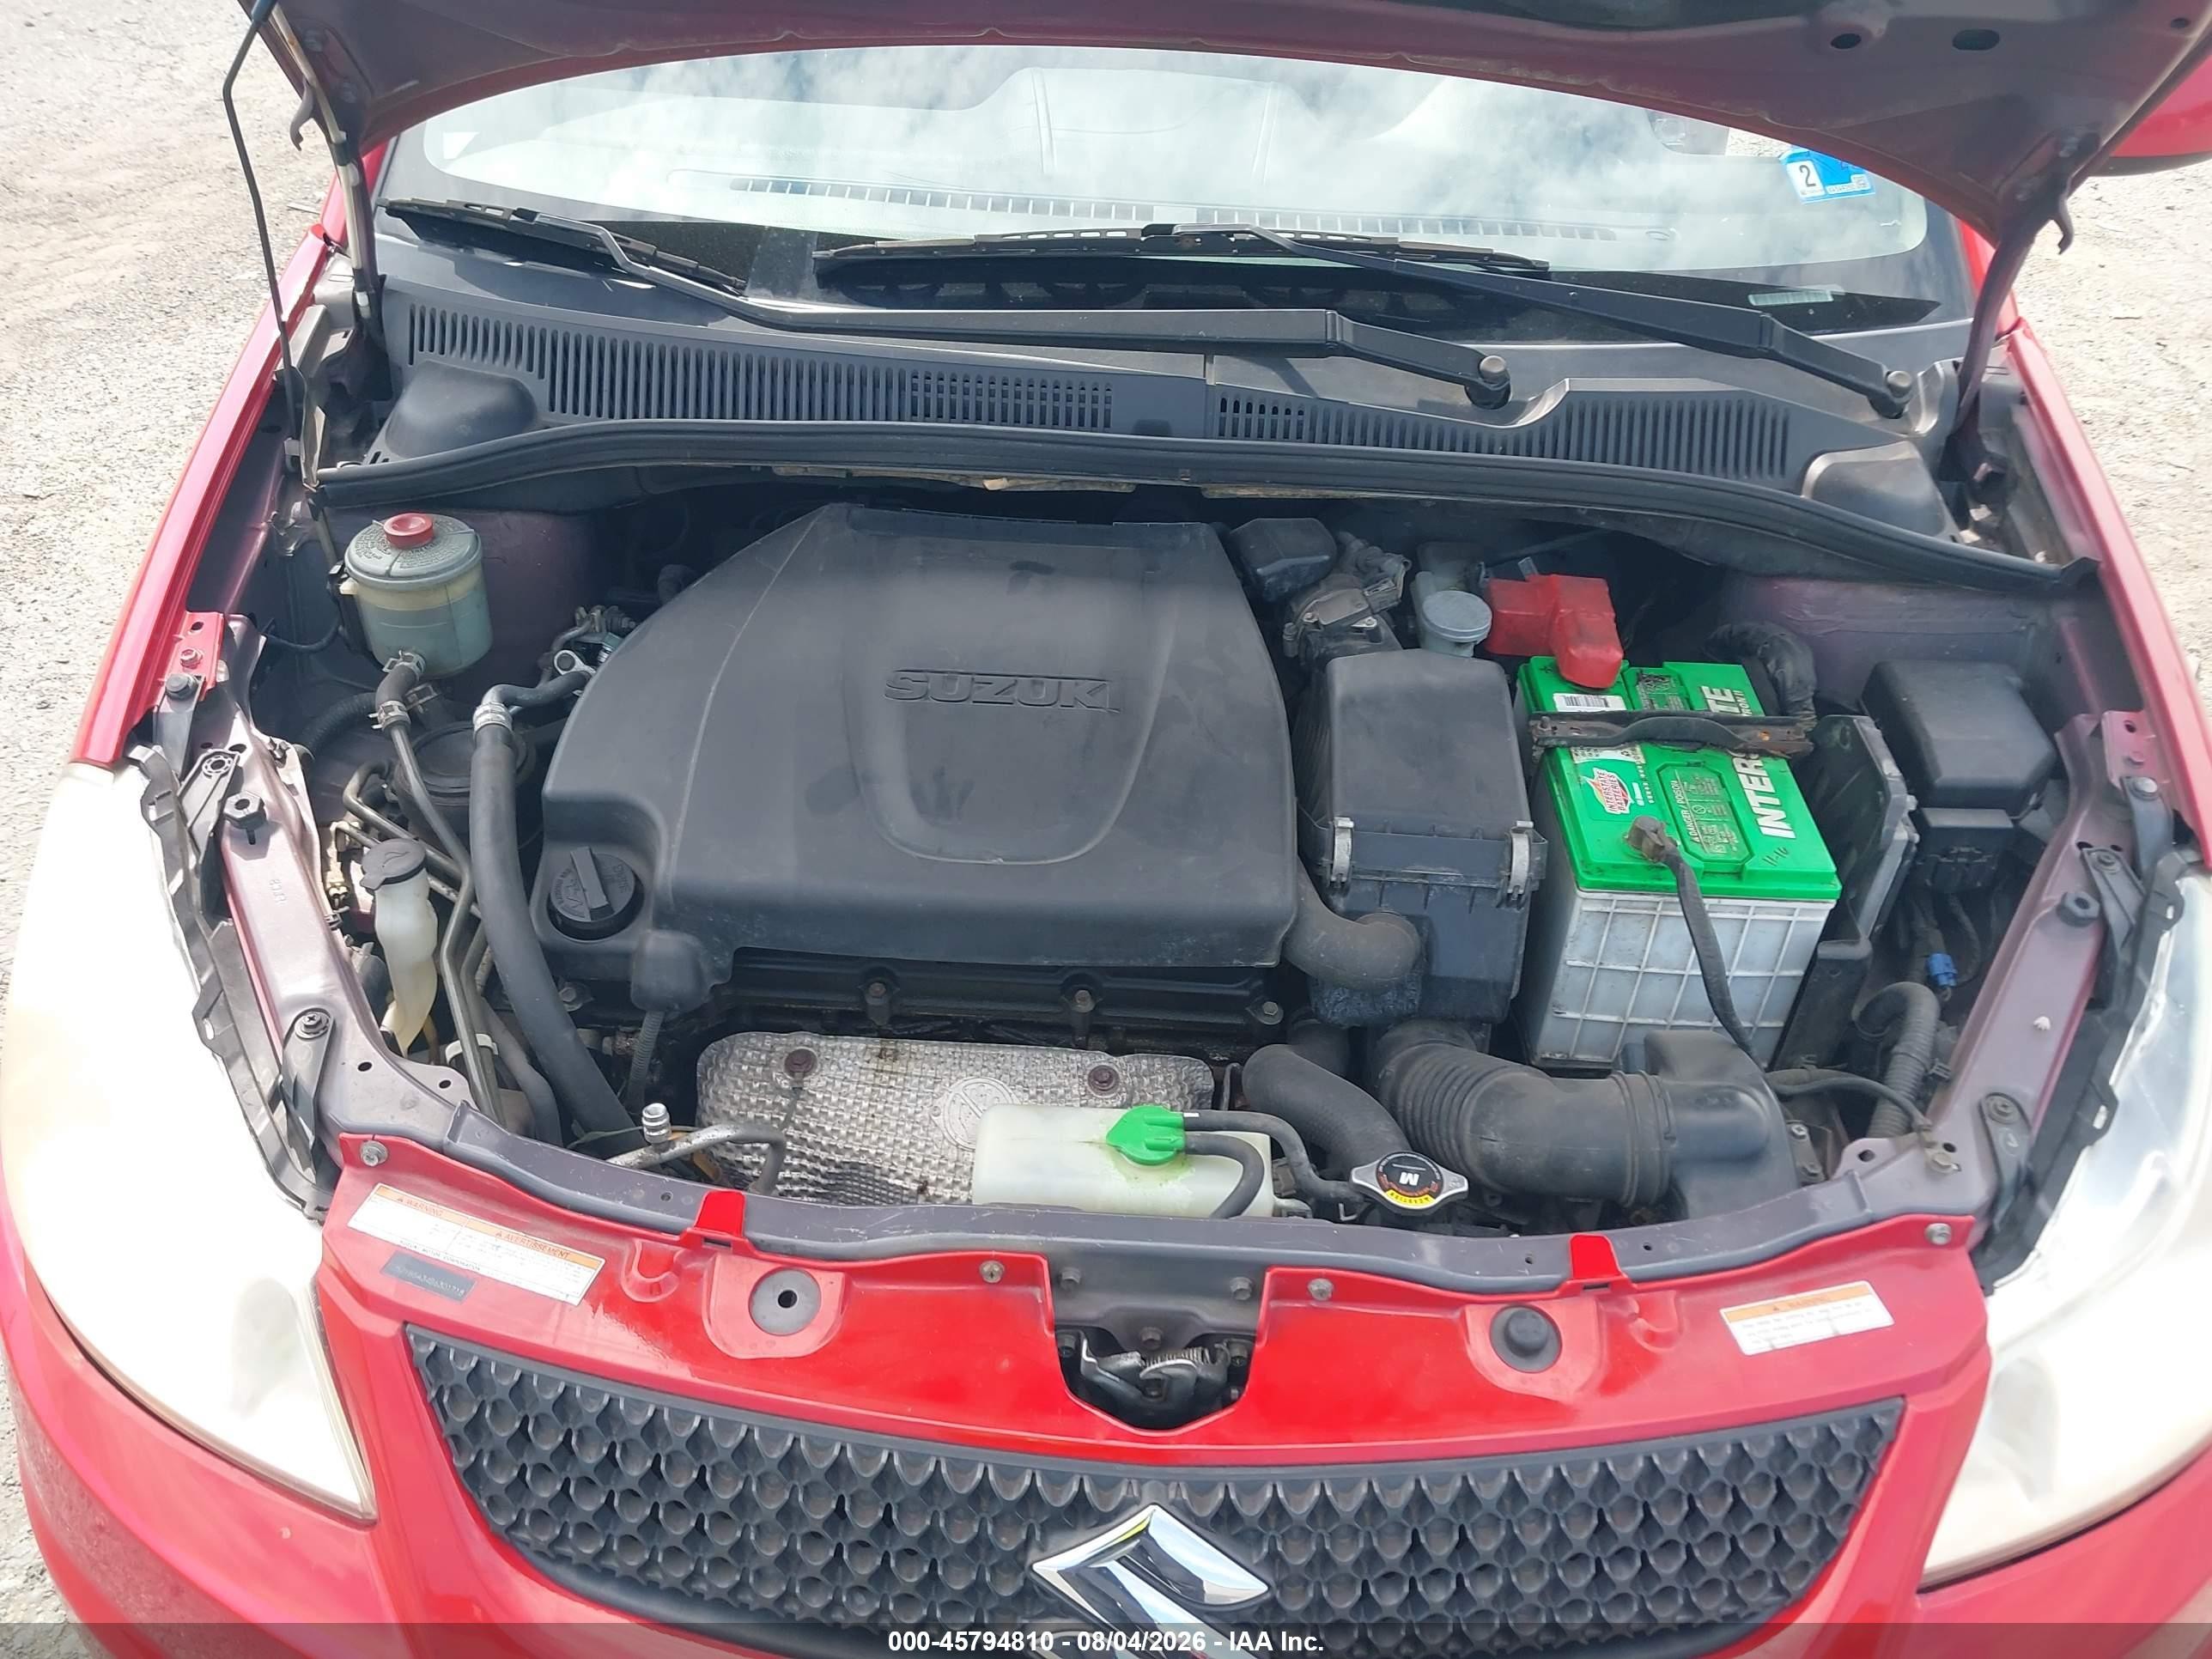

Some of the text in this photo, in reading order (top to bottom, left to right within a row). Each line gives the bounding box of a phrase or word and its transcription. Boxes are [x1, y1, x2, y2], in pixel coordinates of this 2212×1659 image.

[1799, 164, 1816, 187] 2
[1670, 780, 1686, 804] POISON
[1680, 810, 1699, 837] DANGER
[503, 1233, 570, 1259] AVERTISSEMENT
